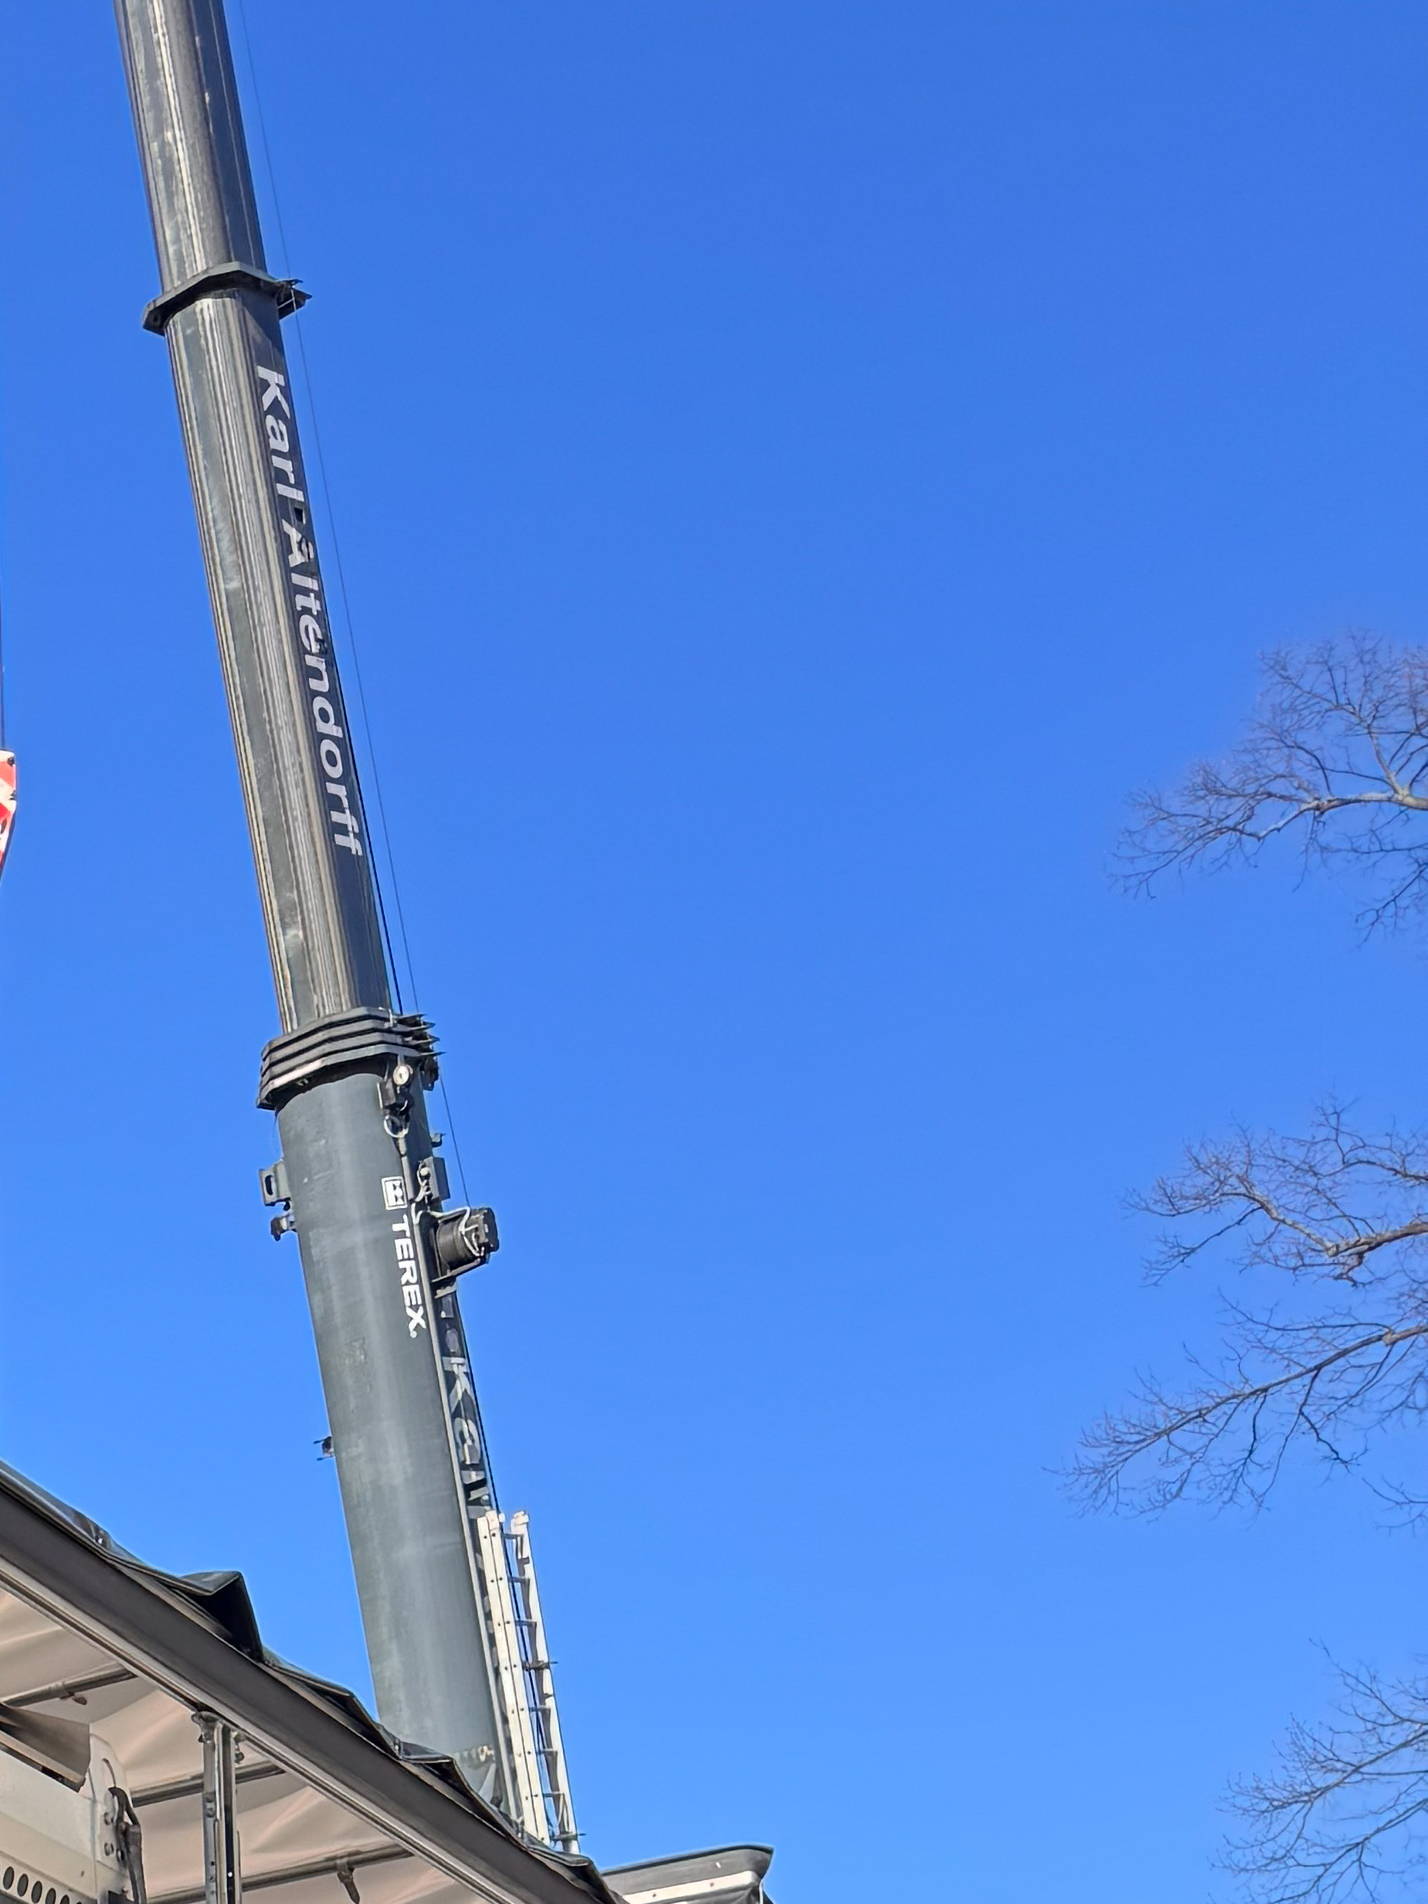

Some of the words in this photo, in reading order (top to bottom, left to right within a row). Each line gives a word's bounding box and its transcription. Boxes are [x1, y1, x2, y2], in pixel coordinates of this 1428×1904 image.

[257, 365, 305, 502] Karl
[282, 518, 363, 857] Altendorff
[391, 1214, 427, 1331] TEREX
